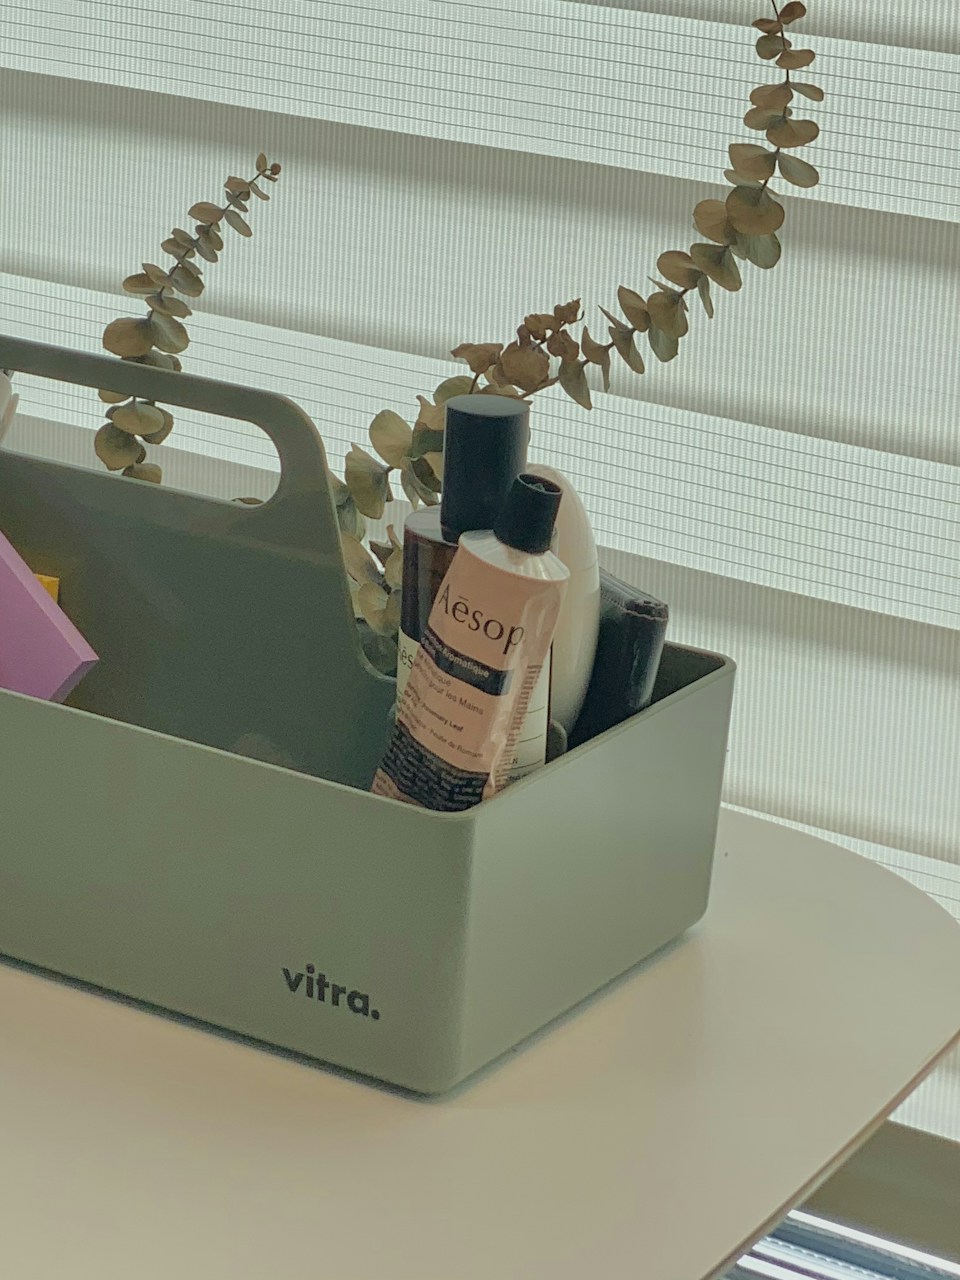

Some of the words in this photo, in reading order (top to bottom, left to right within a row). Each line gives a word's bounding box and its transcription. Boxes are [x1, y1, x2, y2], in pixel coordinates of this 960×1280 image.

[441, 646, 491, 679] Aromatique
[459, 696, 484, 715] Mains
[282, 963, 380, 1020] vitra.
